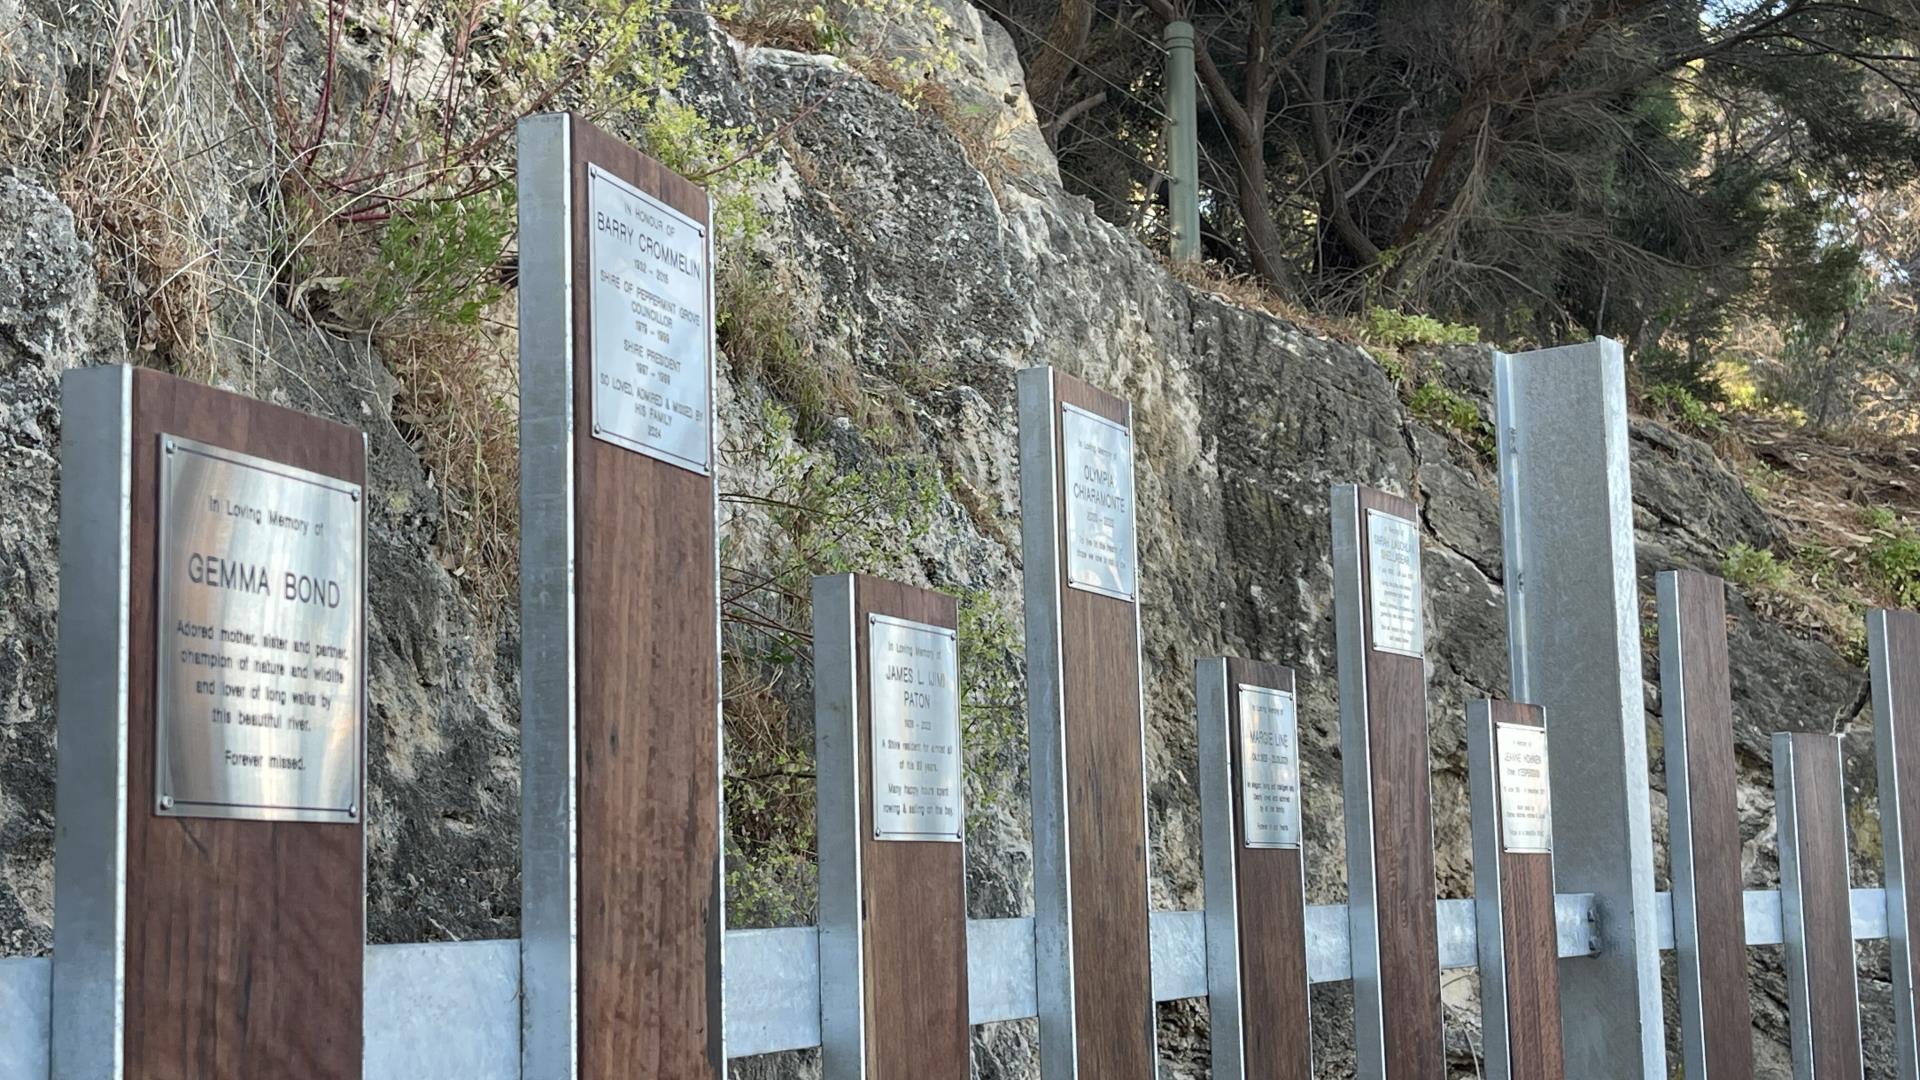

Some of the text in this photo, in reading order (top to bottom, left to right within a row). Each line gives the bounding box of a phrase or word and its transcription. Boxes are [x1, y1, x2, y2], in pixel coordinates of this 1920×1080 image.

[635, 206, 662, 233] HONOUR
[596, 209, 700, 281] BARRY CROMMELIN
[599, 268, 620, 289] SHIRE
[636, 285, 676, 316] PEPPERMINT
[679, 306, 700, 327] GROVE
[631, 299, 672, 330] COUNCILLOR
[623, 337, 680, 373] SHIRE PRESIDENT
[599, 371, 609, 387] SO
[636, 385, 663, 407] ADMIRED
[672, 399, 693, 419] MISSED
[634, 401, 672, 426] HIS FAMILY
[1083, 463, 1114, 489] OLYMPIA
[1073, 481, 1125, 514] CHIARAMONTE
[209, 496, 219, 512] In
[227, 500, 261, 524] Loving
[269, 511, 307, 536] Memory
[188, 551, 339, 609] GEMMA BOND
[177, 619, 213, 640] Adored
[263, 633, 287, 652] sister
[294, 638, 310, 655] and
[896, 642, 912, 656] Loving
[915, 646, 933, 660] Memory
[181, 648, 232, 671] champion
[255, 659, 284, 676] nature
[291, 663, 308, 679] and
[314, 666, 343, 684] wildlife
[885, 663, 913, 683] JAMES
[196, 678, 214, 695] and
[222, 682, 244, 698] lover
[266, 687, 285, 705] long
[292, 690, 315, 706] walks
[322, 694, 332, 710] by
[903, 690, 930, 709] PATON
[212, 707, 231, 724] this
[238, 710, 281, 728] beautiful
[224, 750, 305, 770] Forever missed.
